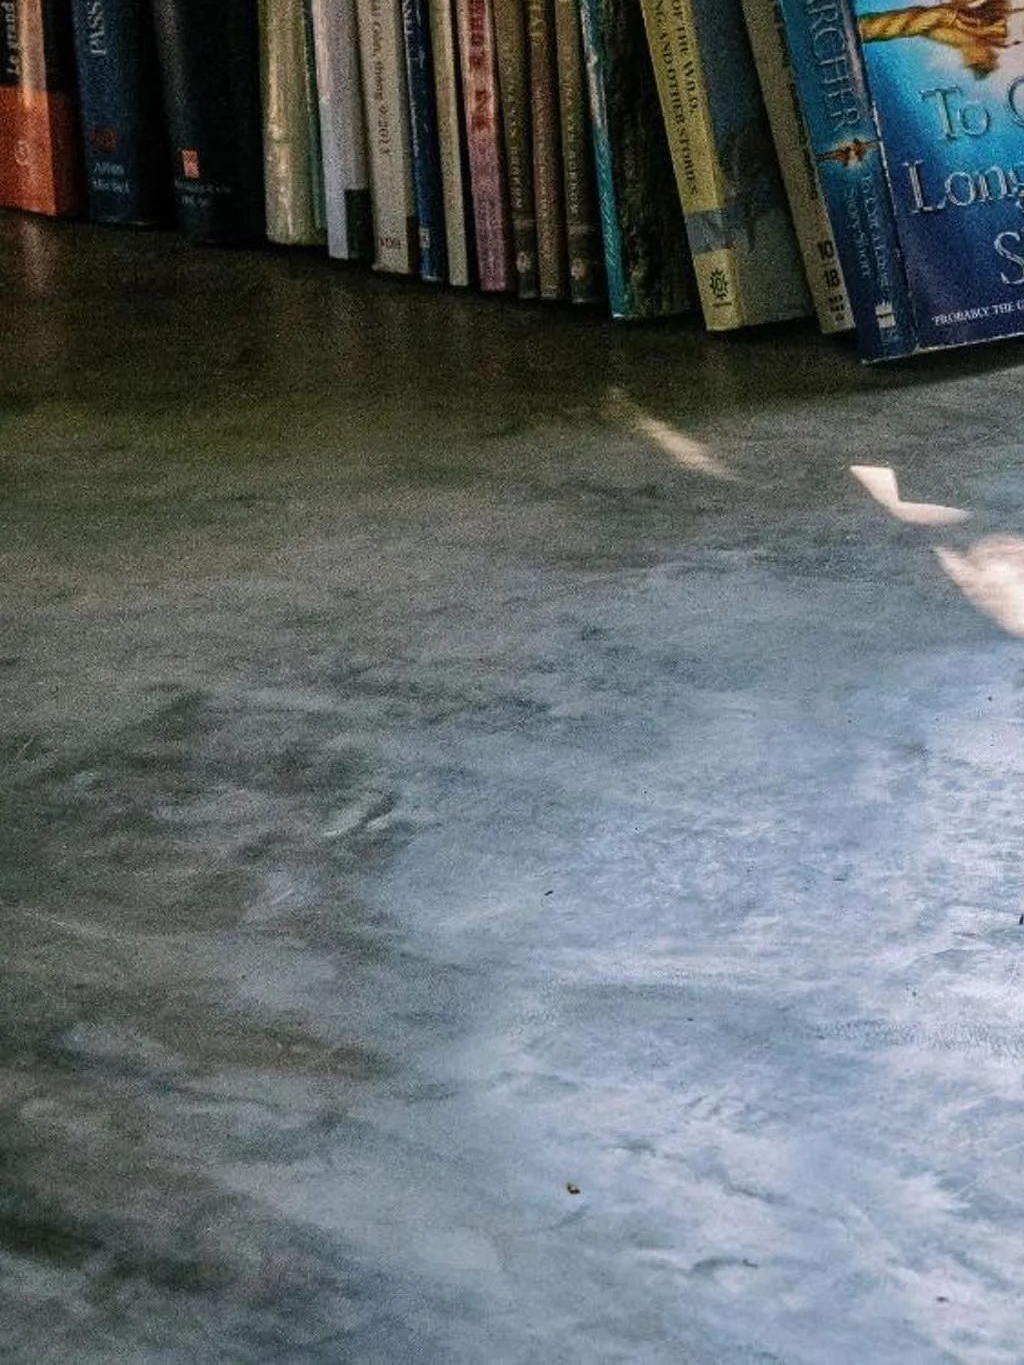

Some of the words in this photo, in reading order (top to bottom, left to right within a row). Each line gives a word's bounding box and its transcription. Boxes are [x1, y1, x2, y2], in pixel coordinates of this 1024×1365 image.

[1, 0, 19, 47] grand
[5, 54, 20, 76] Le
[658, 30, 674, 65] AND
[666, 67, 687, 124] OTHER
[677, 127, 698, 195] STORIES
[922, 86, 991, 140] To
[859, 173, 874, 193] To
[864, 195, 881, 229] Cut
[816, 239, 835, 262] 10
[857, 231, 871, 279] Short
[824, 267, 841, 289] 18
[991, 300, 1015, 315] THE
